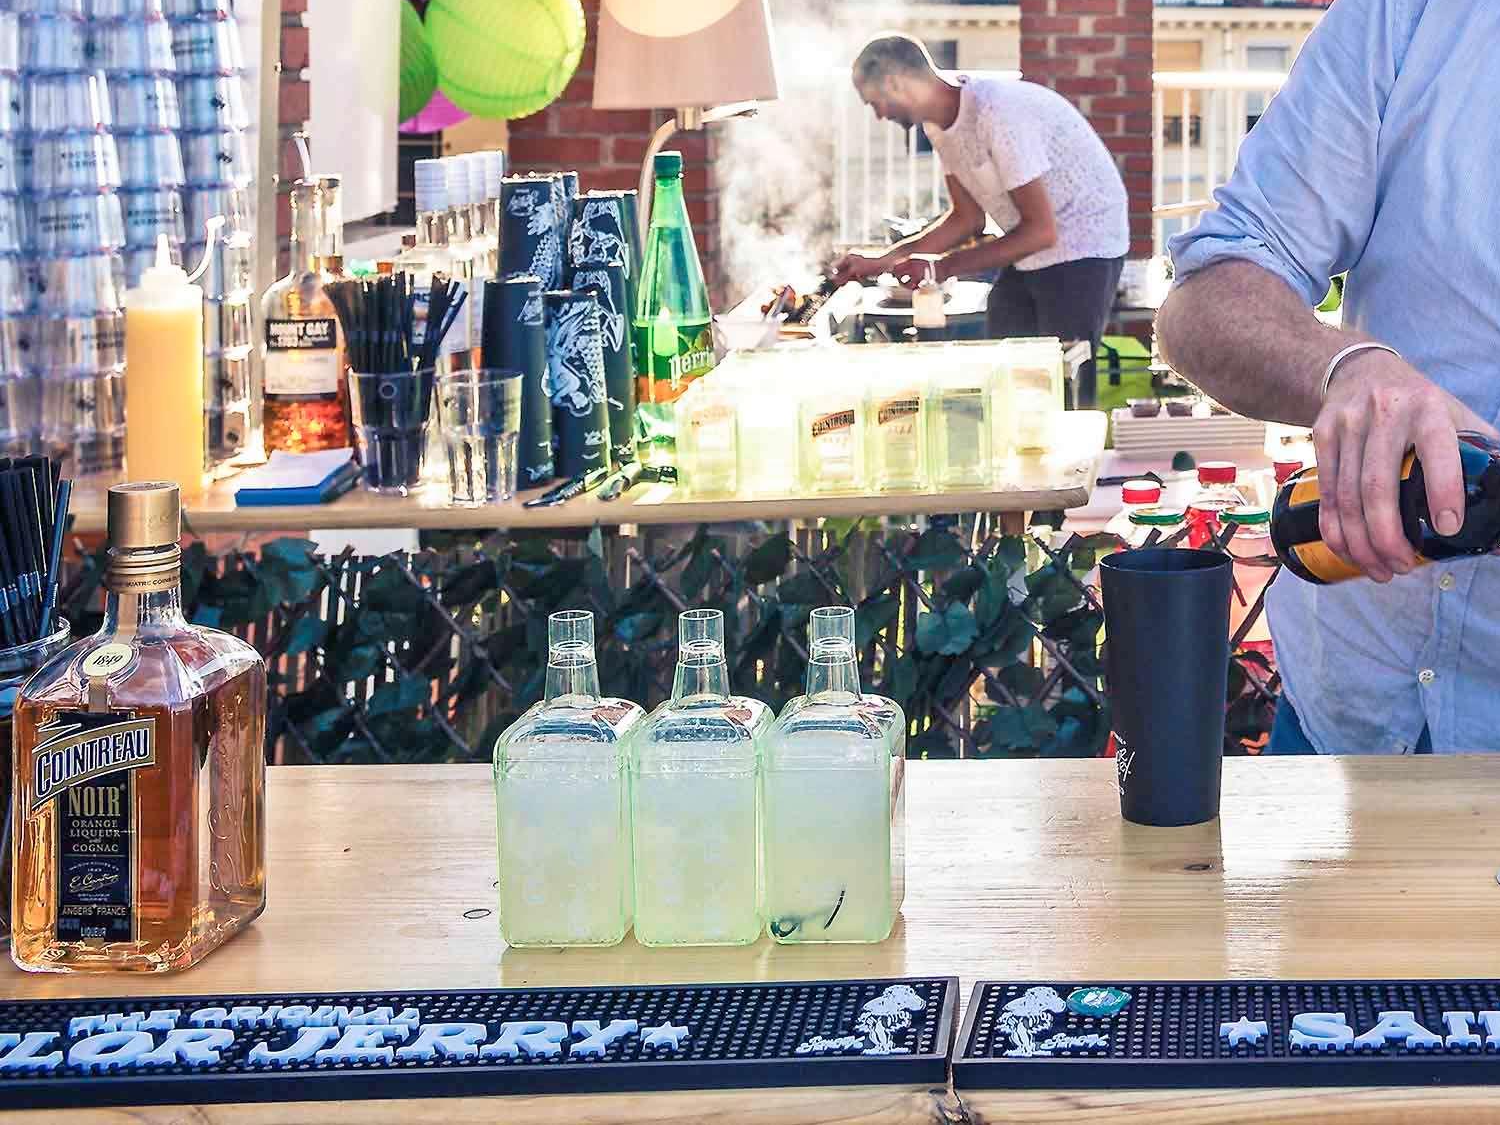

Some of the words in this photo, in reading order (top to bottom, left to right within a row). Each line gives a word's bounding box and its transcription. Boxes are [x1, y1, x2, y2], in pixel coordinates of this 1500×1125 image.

[92, 654, 124, 666] 1849
[36, 728, 150, 796] COINTREAU
[67, 786, 121, 817] NOIR
[71, 819, 118, 828] ORANGE
[69, 829, 121, 839] LIQUEUR
[72, 843, 119, 852] COGNAC
[63, 907, 93, 916] ANGERS
[96, 907, 126, 916] FRANCE
[0, 1027, 236, 1072] LOR
[248, 1019, 638, 1065] JERRY
